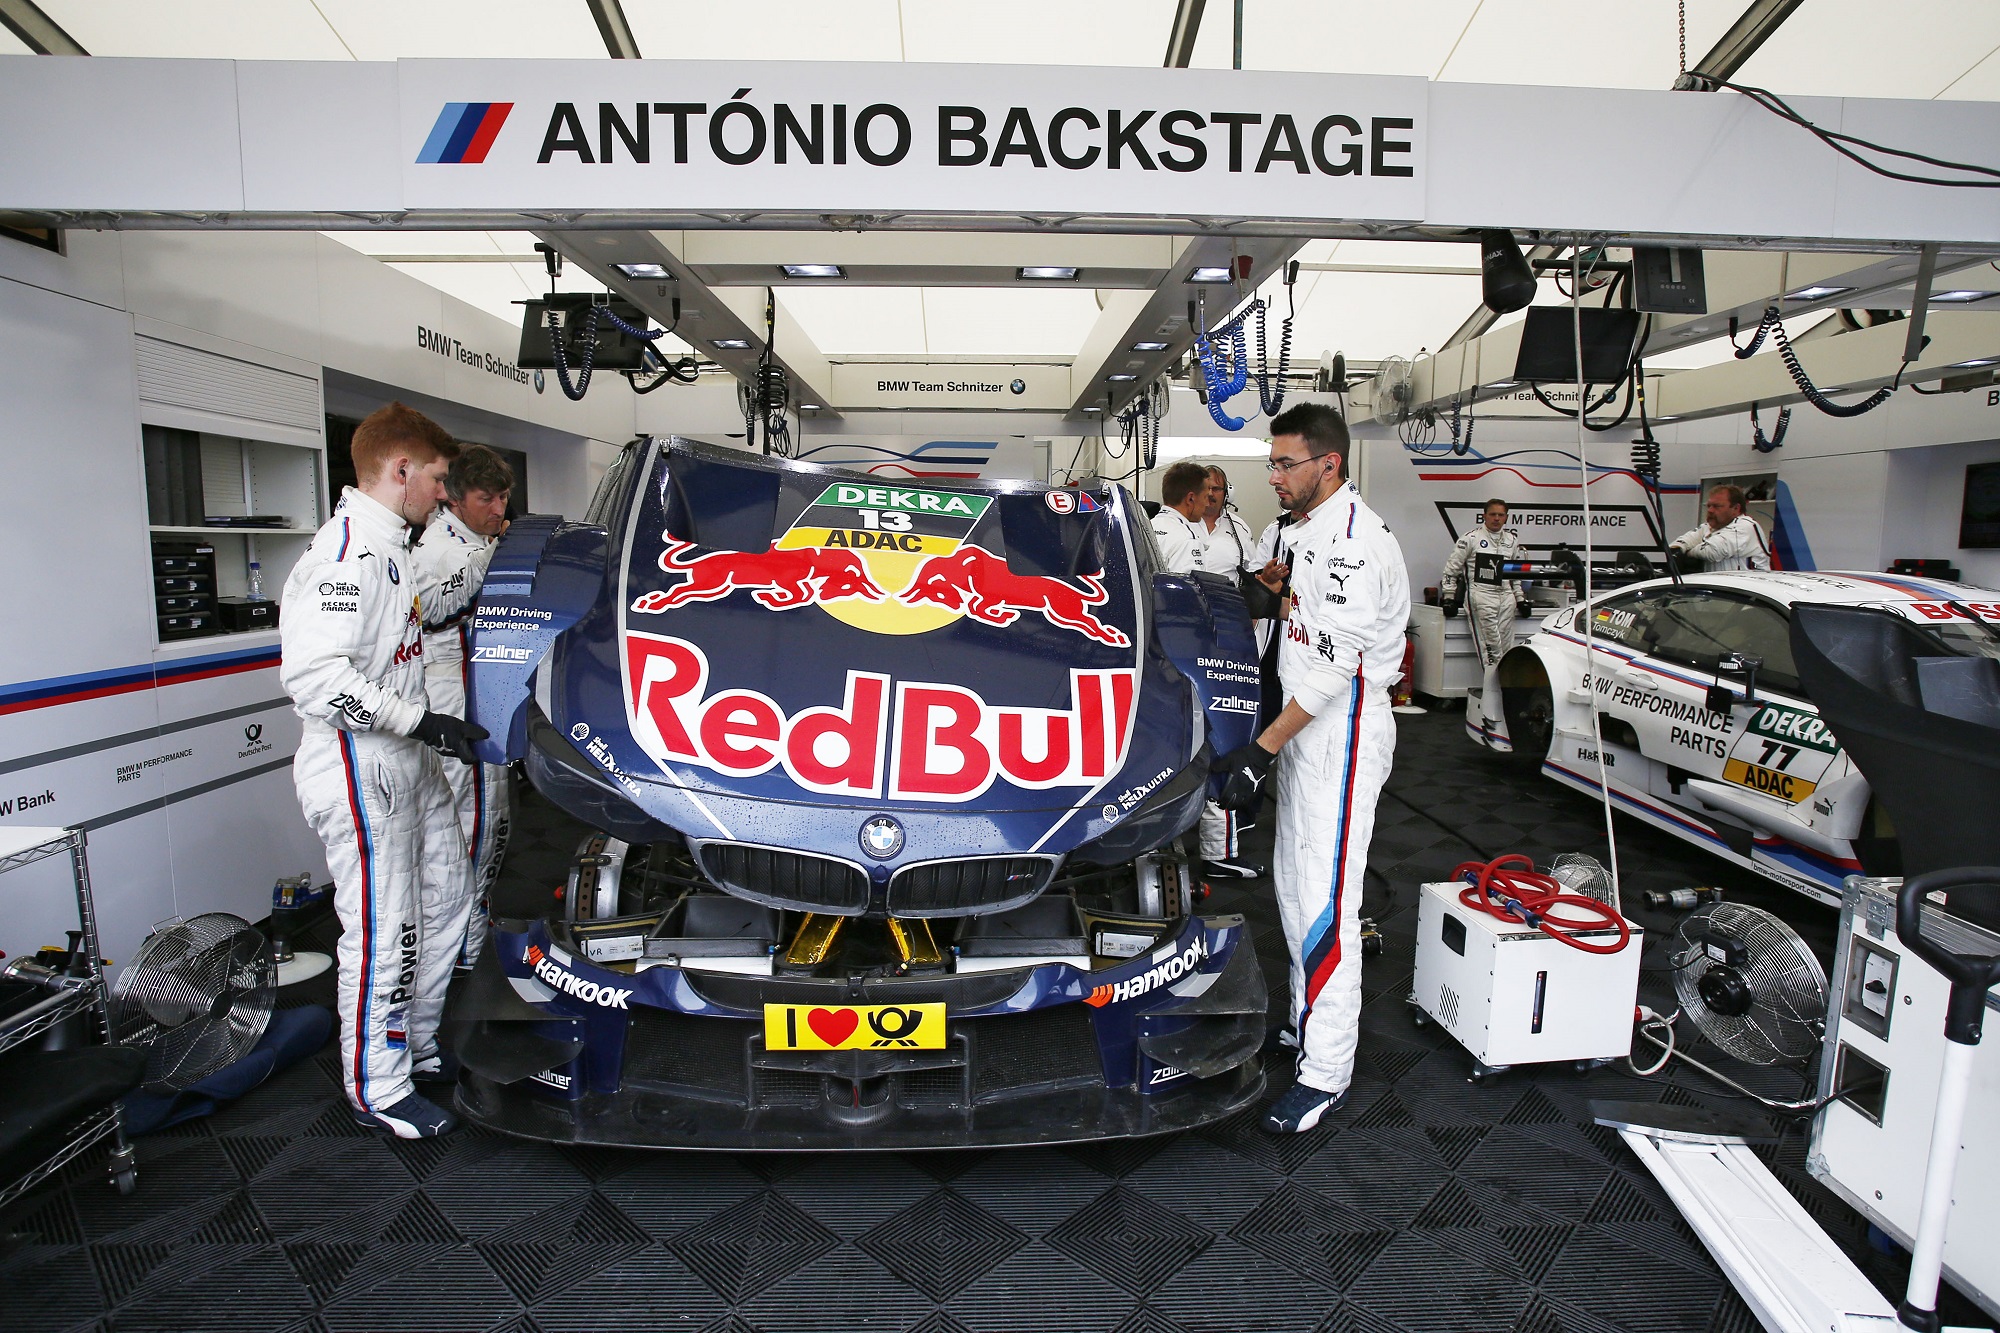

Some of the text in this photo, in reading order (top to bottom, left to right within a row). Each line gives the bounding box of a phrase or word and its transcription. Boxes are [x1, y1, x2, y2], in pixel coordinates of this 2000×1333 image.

[536, 87, 1414, 178] ANTÓNIO BACKSTAGE
[417, 325, 530, 386] BMW Team Schnitzer
[877, 381, 1003, 392] BMW Team Schnitzer
[1544, 390, 1596, 402] Schniter
[837, 486, 974, 516] DEKRA
[857, 508, 914, 532] 13
[1511, 514, 1523, 525] M
[824, 530, 923, 553] ADAC
[336, 583, 361, 592] HELIX
[474, 618, 540, 631] Experience
[476, 606, 553, 621] BMW Driving
[1608, 609, 1637, 629] TOM
[1287, 618, 1310, 647] Bull
[1592, 621, 1626, 639] Tomczyk
[393, 628, 423, 666] Red
[470, 644, 534, 665] zollner
[1197, 657, 1260, 675] BMW Driving
[1206, 669, 1260, 685] Experience
[1719, 661, 1739, 670] PUMA
[626, 635, 1133, 795] Red Bull
[1208, 695, 1260, 715] zollner
[1611, 685, 1735, 735] PERFORMANCE
[1758, 707, 1837, 749] DEKRA
[238, 743, 273, 759] Deutsche Post
[1670, 725, 1727, 759] PARTS
[116, 748, 193, 776] BMW M PERFORMANCE
[585, 740, 616, 774] HELIX
[1757, 739, 1802, 772] 77
[117, 770, 141, 784] PARTS
[613, 767, 642, 798] ULTRA
[1147, 767, 1175, 790] ULTRA
[1744, 764, 1794, 799] ADAC
[17, 789, 55, 811] Bank
[1121, 785, 1152, 811] HELIX
[487, 817, 509, 880] Power
[1753, 863, 1822, 899] bmw-motorsport.com
[390, 922, 417, 1006] Power
[786, 1008, 797, 1048] I
